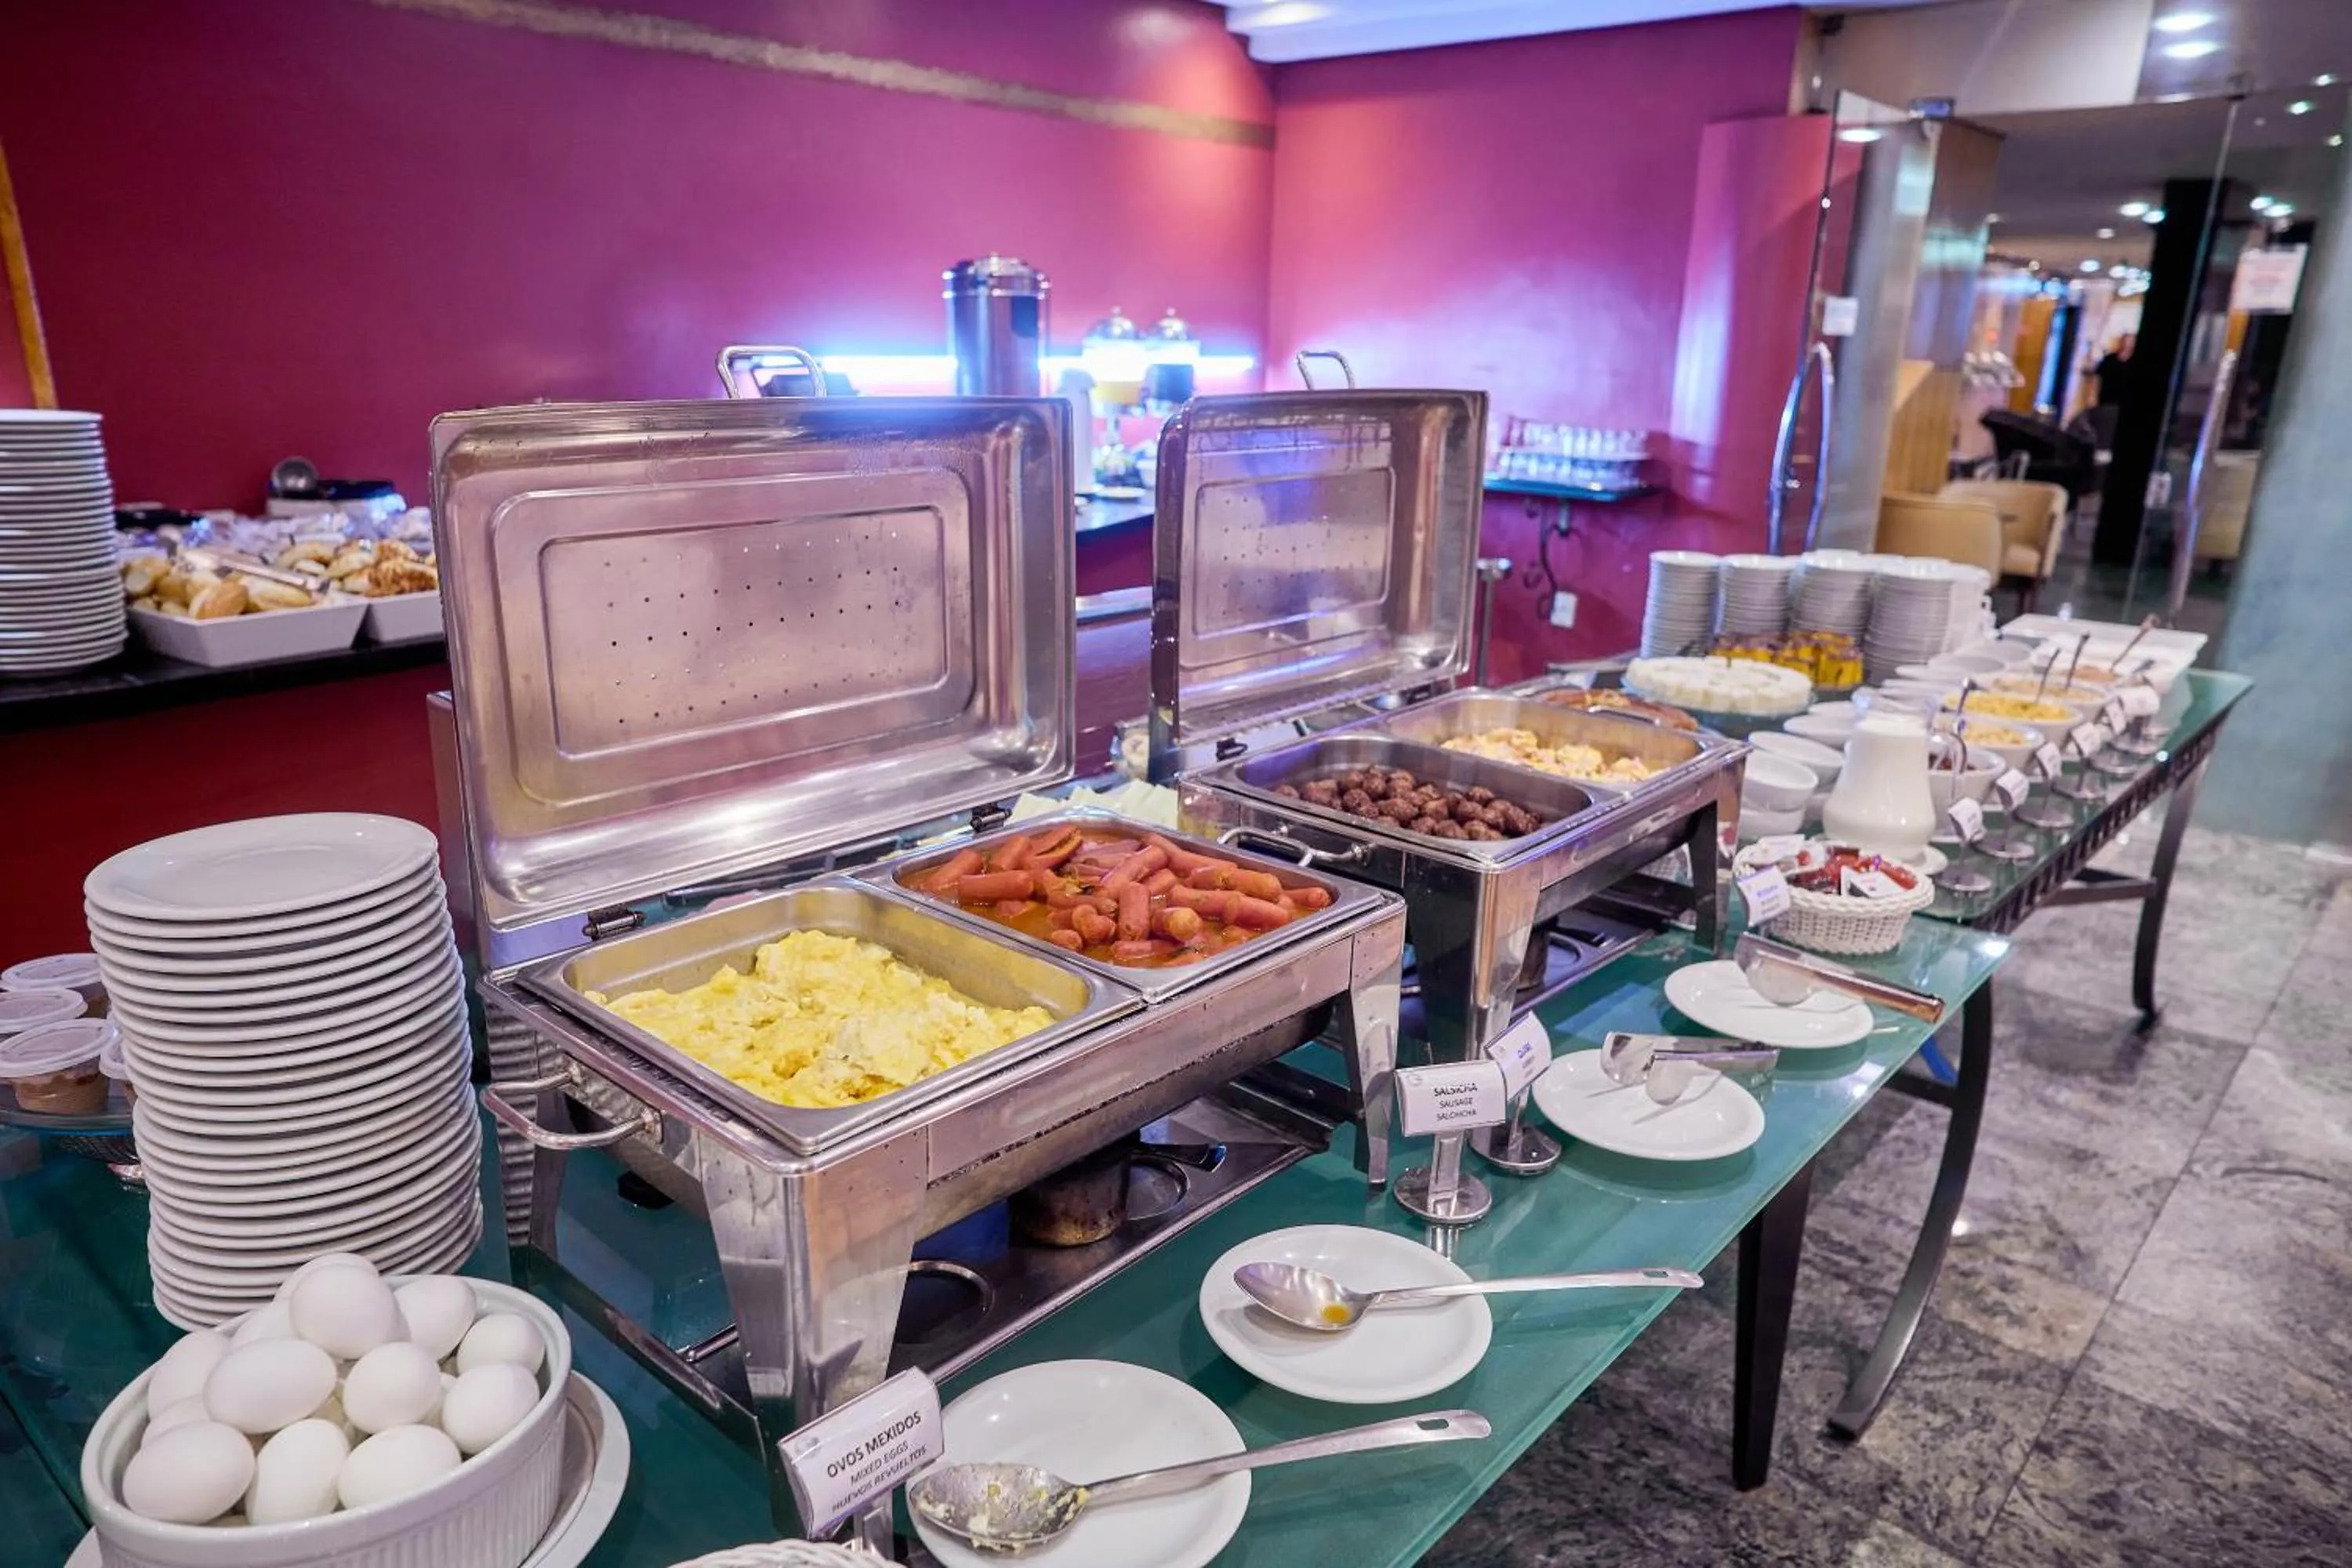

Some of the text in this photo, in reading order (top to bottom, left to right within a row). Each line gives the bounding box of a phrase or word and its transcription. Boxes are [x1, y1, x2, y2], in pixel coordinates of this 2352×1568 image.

[1439, 1097, 1473, 1109] SAUSAGE
[827, 1410, 922, 1478] OVOS MEXIDOS
[851, 1440, 909, 1486] MIXED EGGS
[832, 1444, 927, 1513] HUEVOS REVUELTOS
